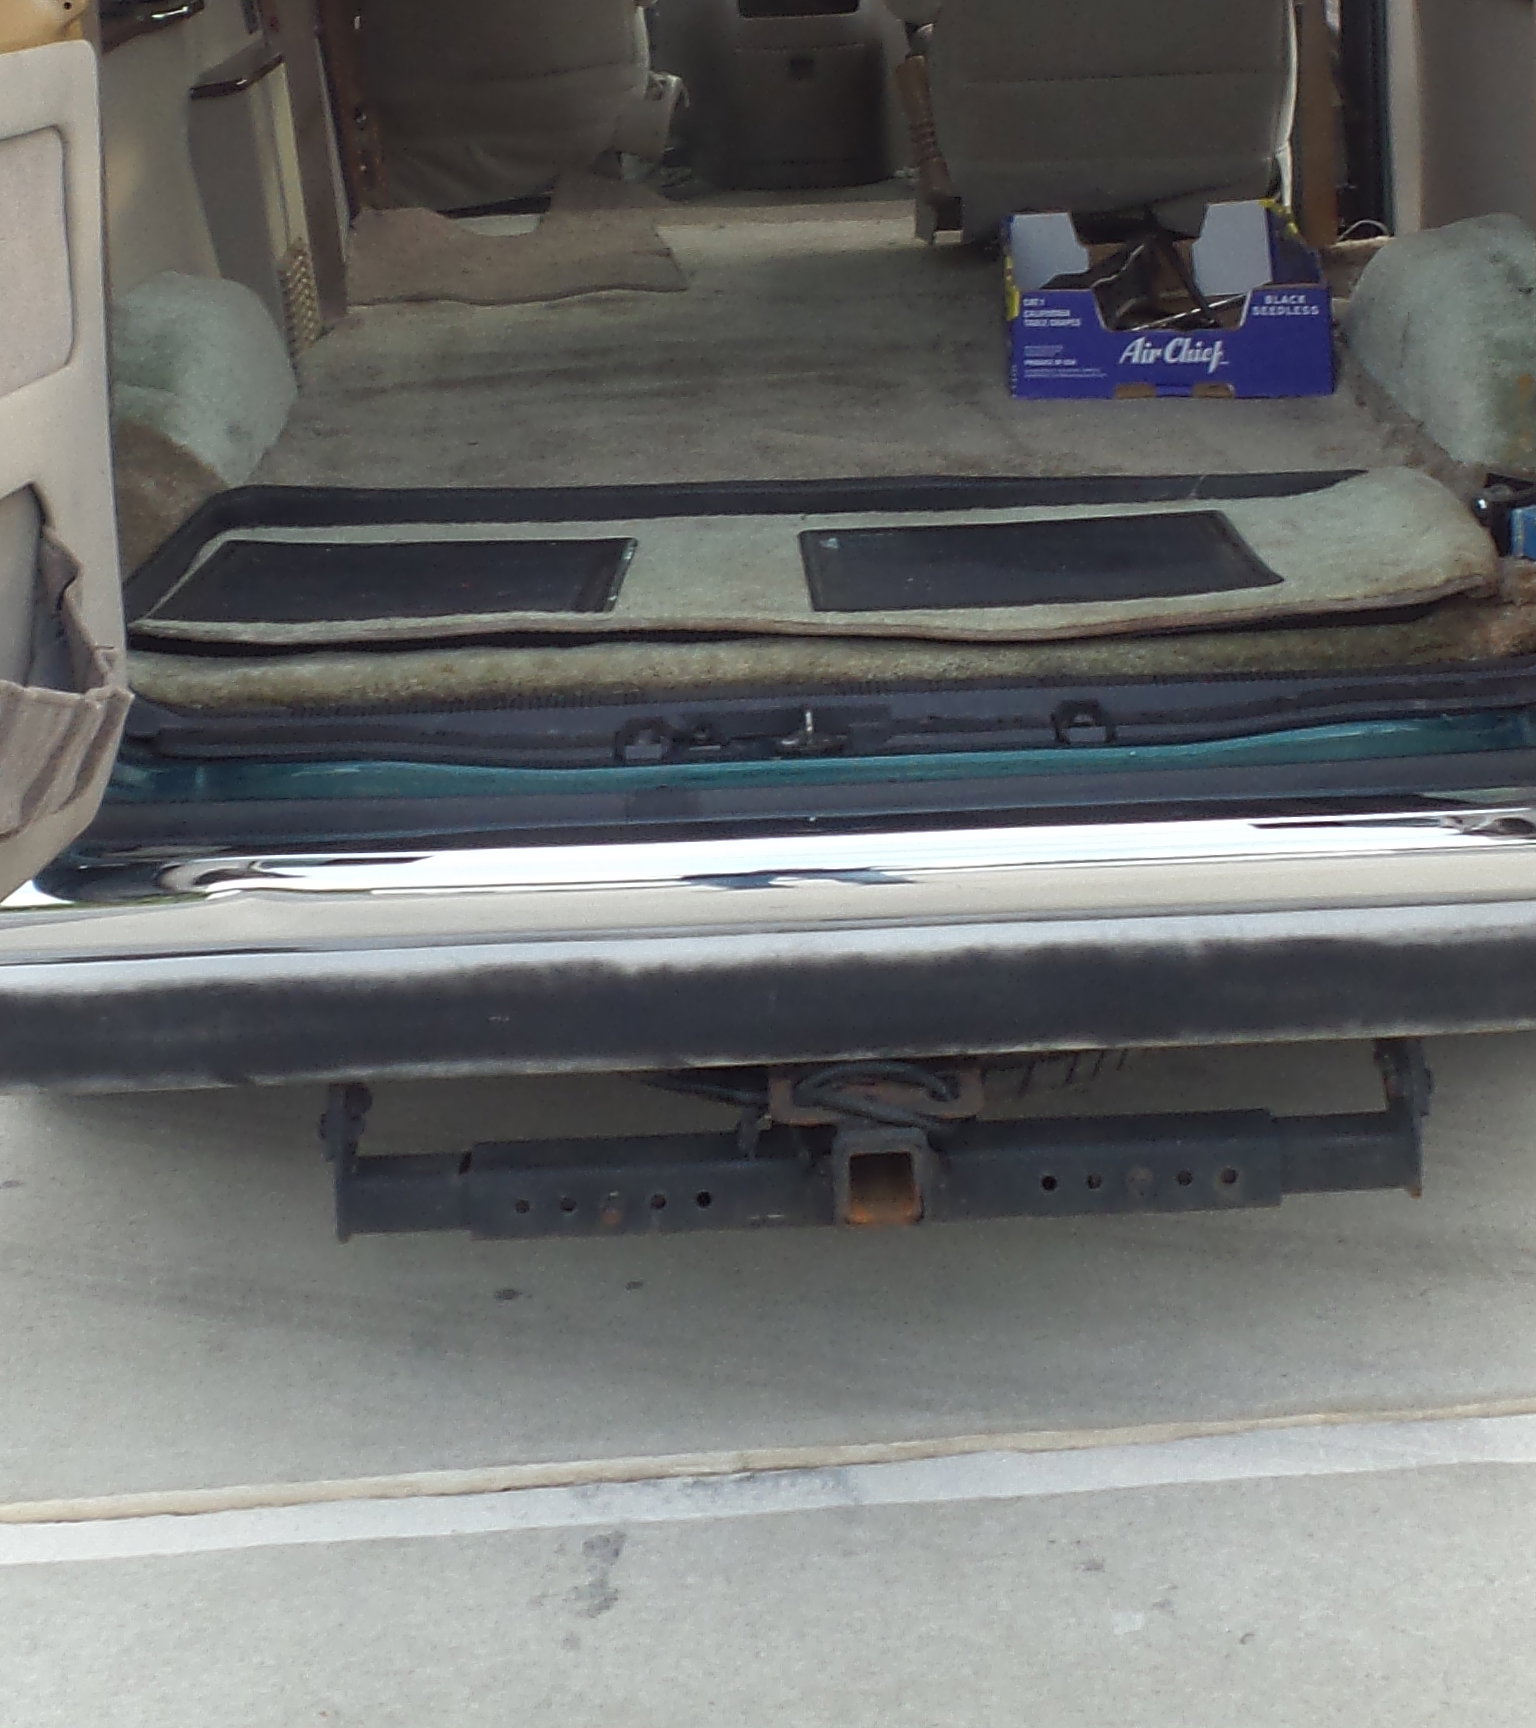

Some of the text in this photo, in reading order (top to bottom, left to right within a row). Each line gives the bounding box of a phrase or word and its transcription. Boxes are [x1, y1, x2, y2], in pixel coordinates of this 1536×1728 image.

[1265, 295, 1306, 304] BLACK
[1251, 305, 1320, 316] SEEDLESS
[1118, 336, 1162, 364] Air
